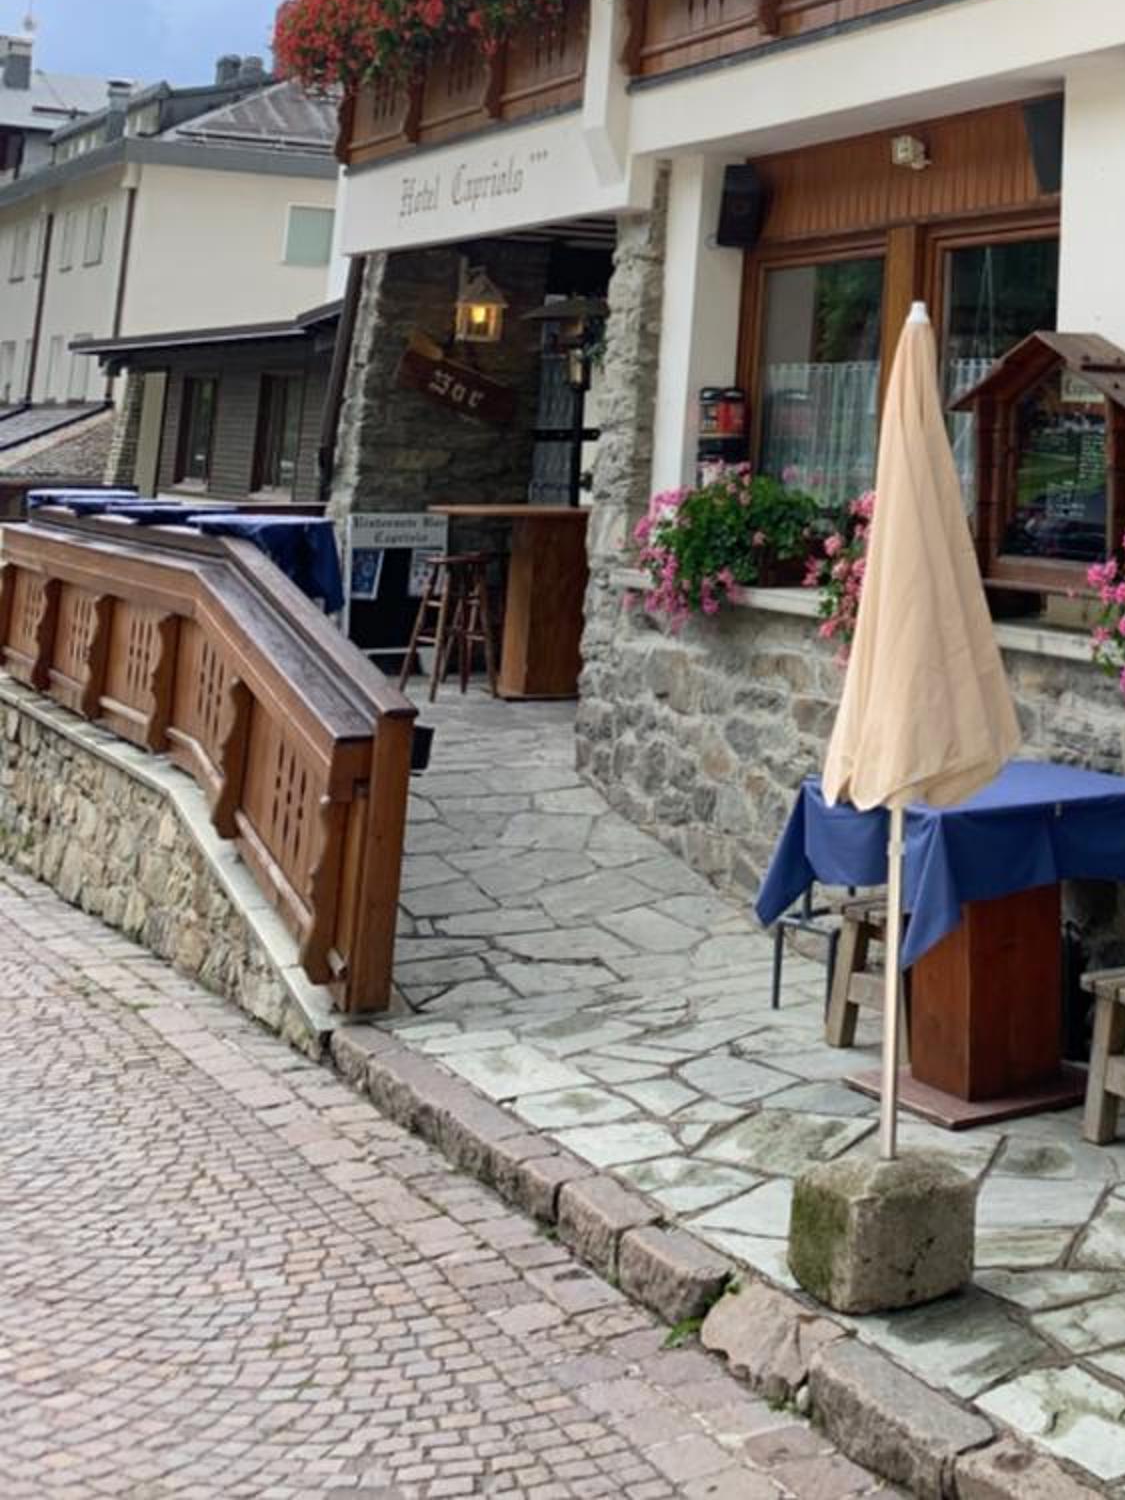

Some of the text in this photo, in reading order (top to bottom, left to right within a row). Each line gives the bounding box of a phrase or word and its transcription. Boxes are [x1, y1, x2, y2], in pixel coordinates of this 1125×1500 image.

[399, 153, 524, 217] Hotel Capriolo
[428, 369, 485, 408] Bar
